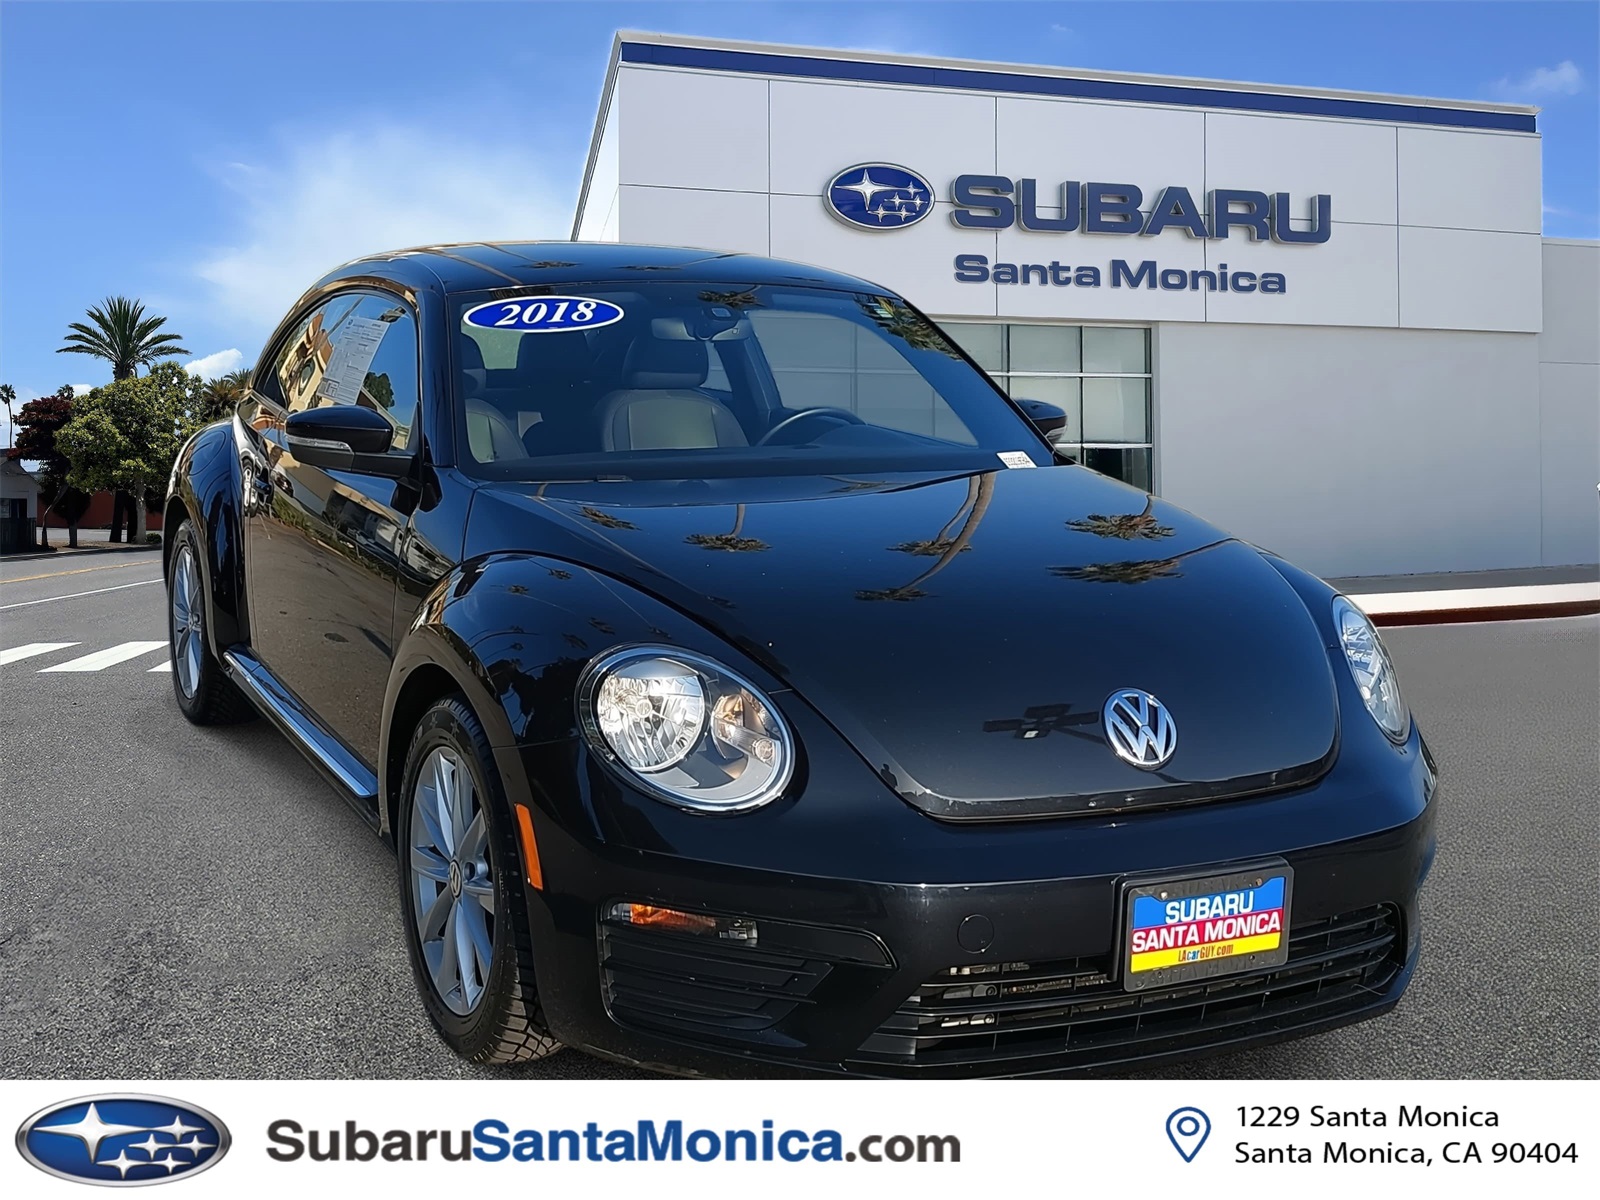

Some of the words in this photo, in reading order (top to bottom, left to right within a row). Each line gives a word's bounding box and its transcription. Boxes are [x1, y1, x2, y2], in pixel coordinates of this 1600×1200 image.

[949, 174, 1332, 245] SUBARU
[954, 254, 1101, 288] Santa
[1110, 259, 1287, 294] Monica
[494, 301, 598, 327] 2018
[1165, 890, 1254, 924] SUBARU
[1132, 924, 1200, 952] SANTA
[1204, 911, 1281, 943] MONICA
[1178, 944, 1234, 962] LAcarGUY.com
